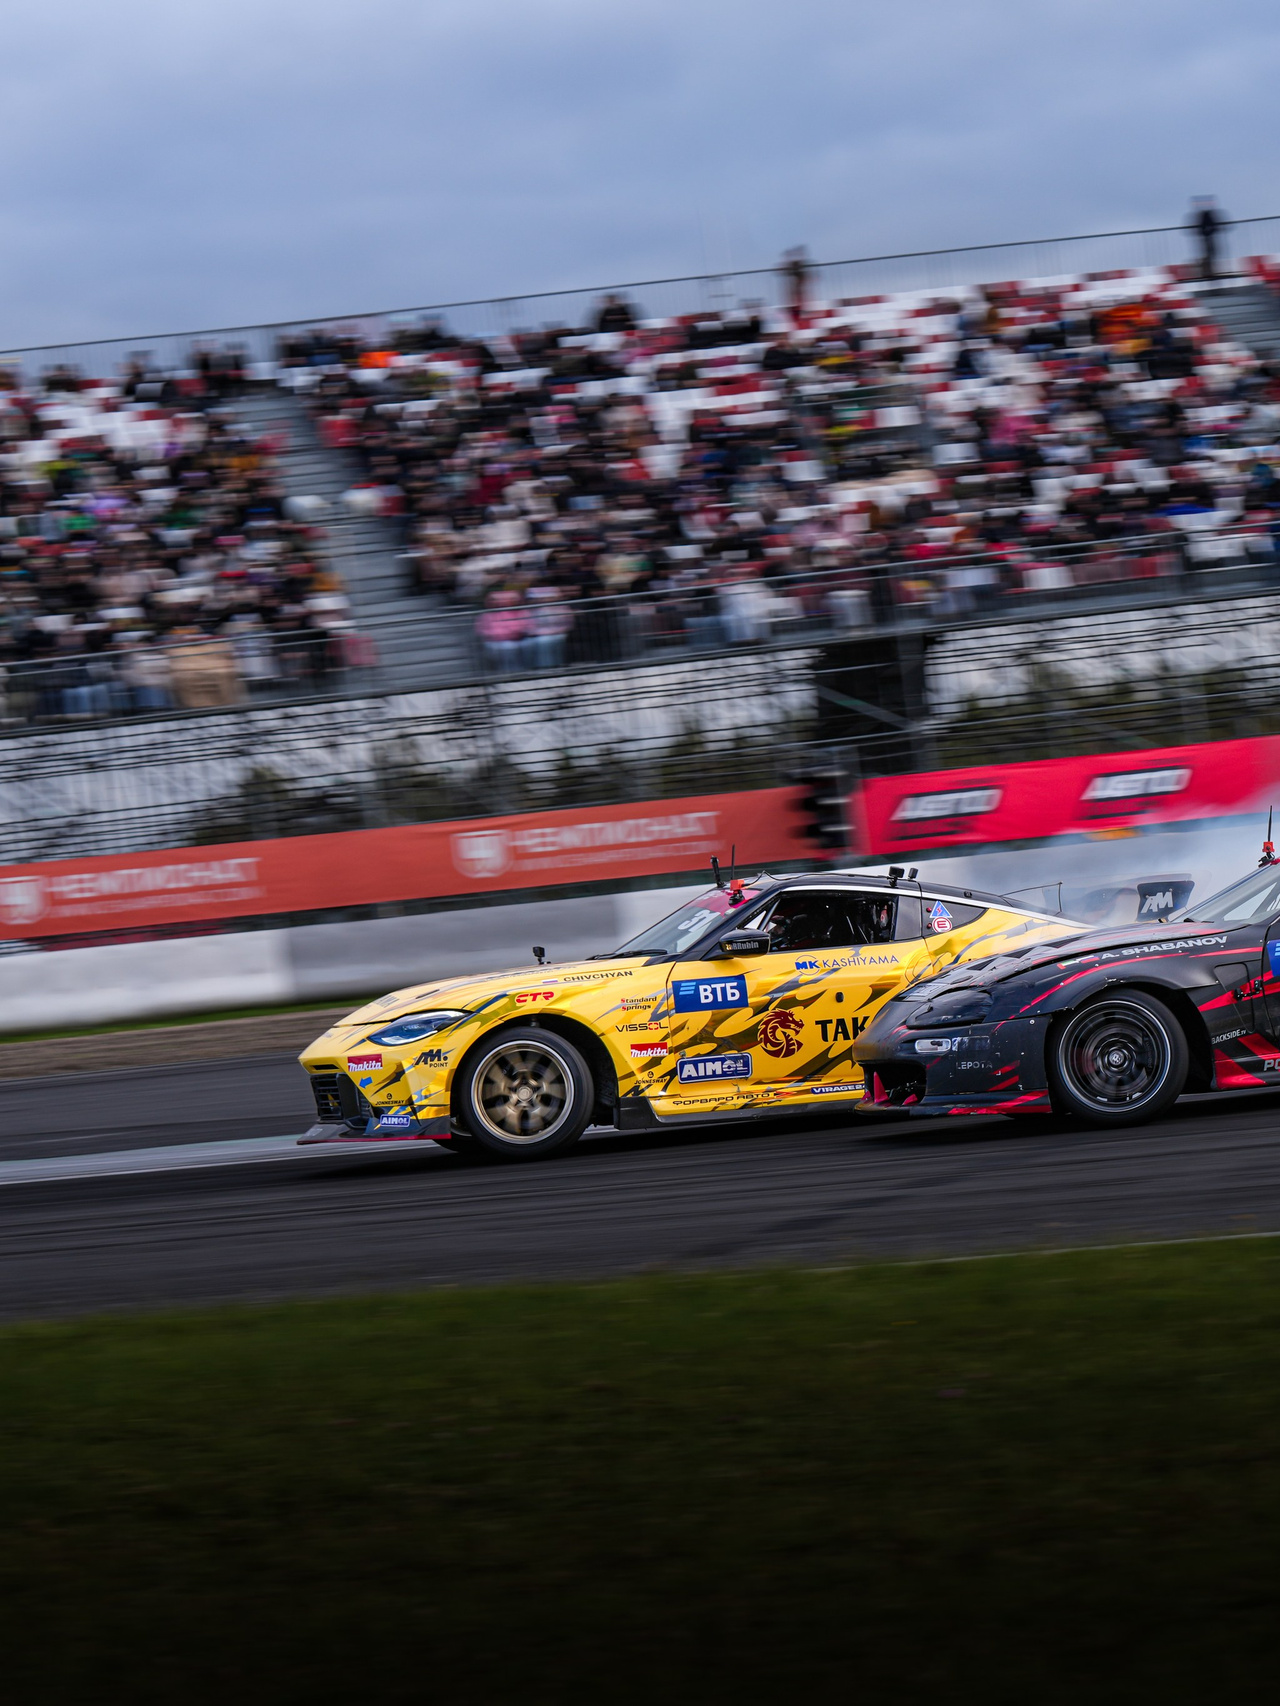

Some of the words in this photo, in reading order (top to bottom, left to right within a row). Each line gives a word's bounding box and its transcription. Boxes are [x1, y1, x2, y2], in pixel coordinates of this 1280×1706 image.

[1101, 952, 1120, 960] A.
[1122, 935, 1228, 956] SHABANOV
[795, 959, 821, 970] MK
[822, 955, 900, 968] KASHIYAMA
[563, 970, 634, 982] CHIVCHYAN
[515, 991, 555, 1004] CTR
[699, 982, 740, 1004] ВТБ
[621, 996, 657, 1004] Standard
[621, 1003, 652, 1011] Springs
[615, 1022, 669, 1033] VISSOL
[681, 1059, 749, 1079] AIMOL
[381, 1116, 409, 1126] AIMOL
